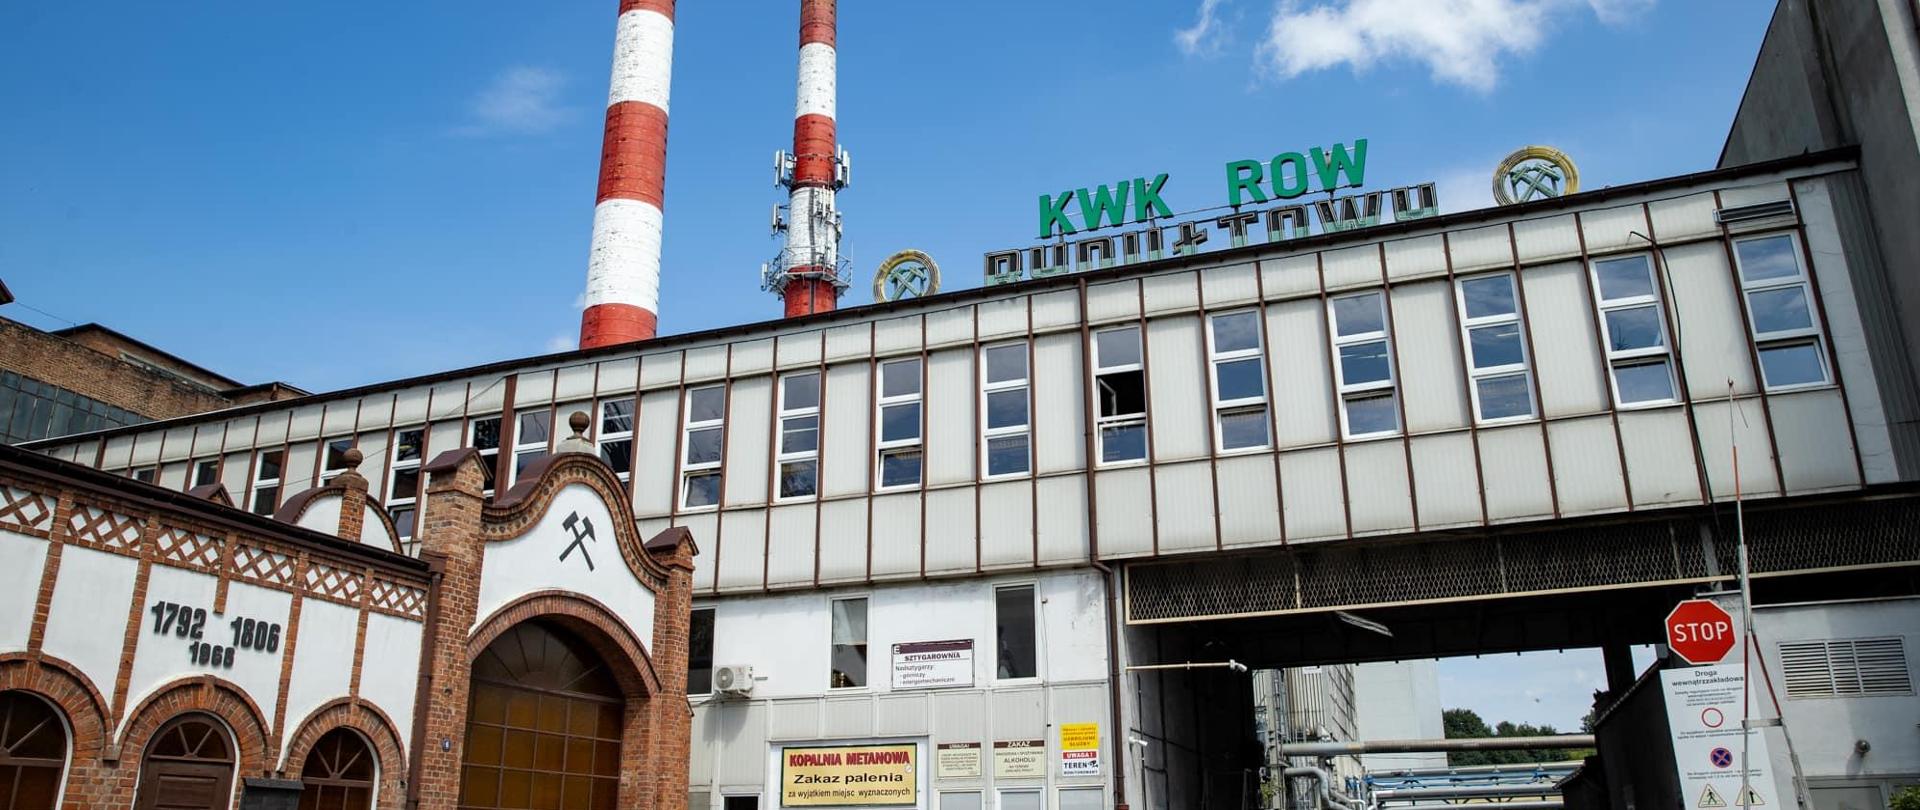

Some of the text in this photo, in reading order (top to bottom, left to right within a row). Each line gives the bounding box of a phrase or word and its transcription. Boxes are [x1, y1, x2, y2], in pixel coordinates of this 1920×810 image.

[1039, 138, 1368, 238] KWK ROW
[151, 600, 281, 653] 1792 1806
[1674, 621, 1728, 643] STOP
[189, 641, 236, 668] 1968
[904, 651, 961, 662] SZTYGAROWNIA
[1695, 670, 1717, 678] Droga
[1008, 740, 1031, 748] ZAKAZ
[789, 751, 910, 767] KOPALNIA METANOWA
[794, 773, 903, 785] Zakaz palenia
[832, 788, 855, 799] miejsc
[858, 786, 911, 799] wyznaczonych
